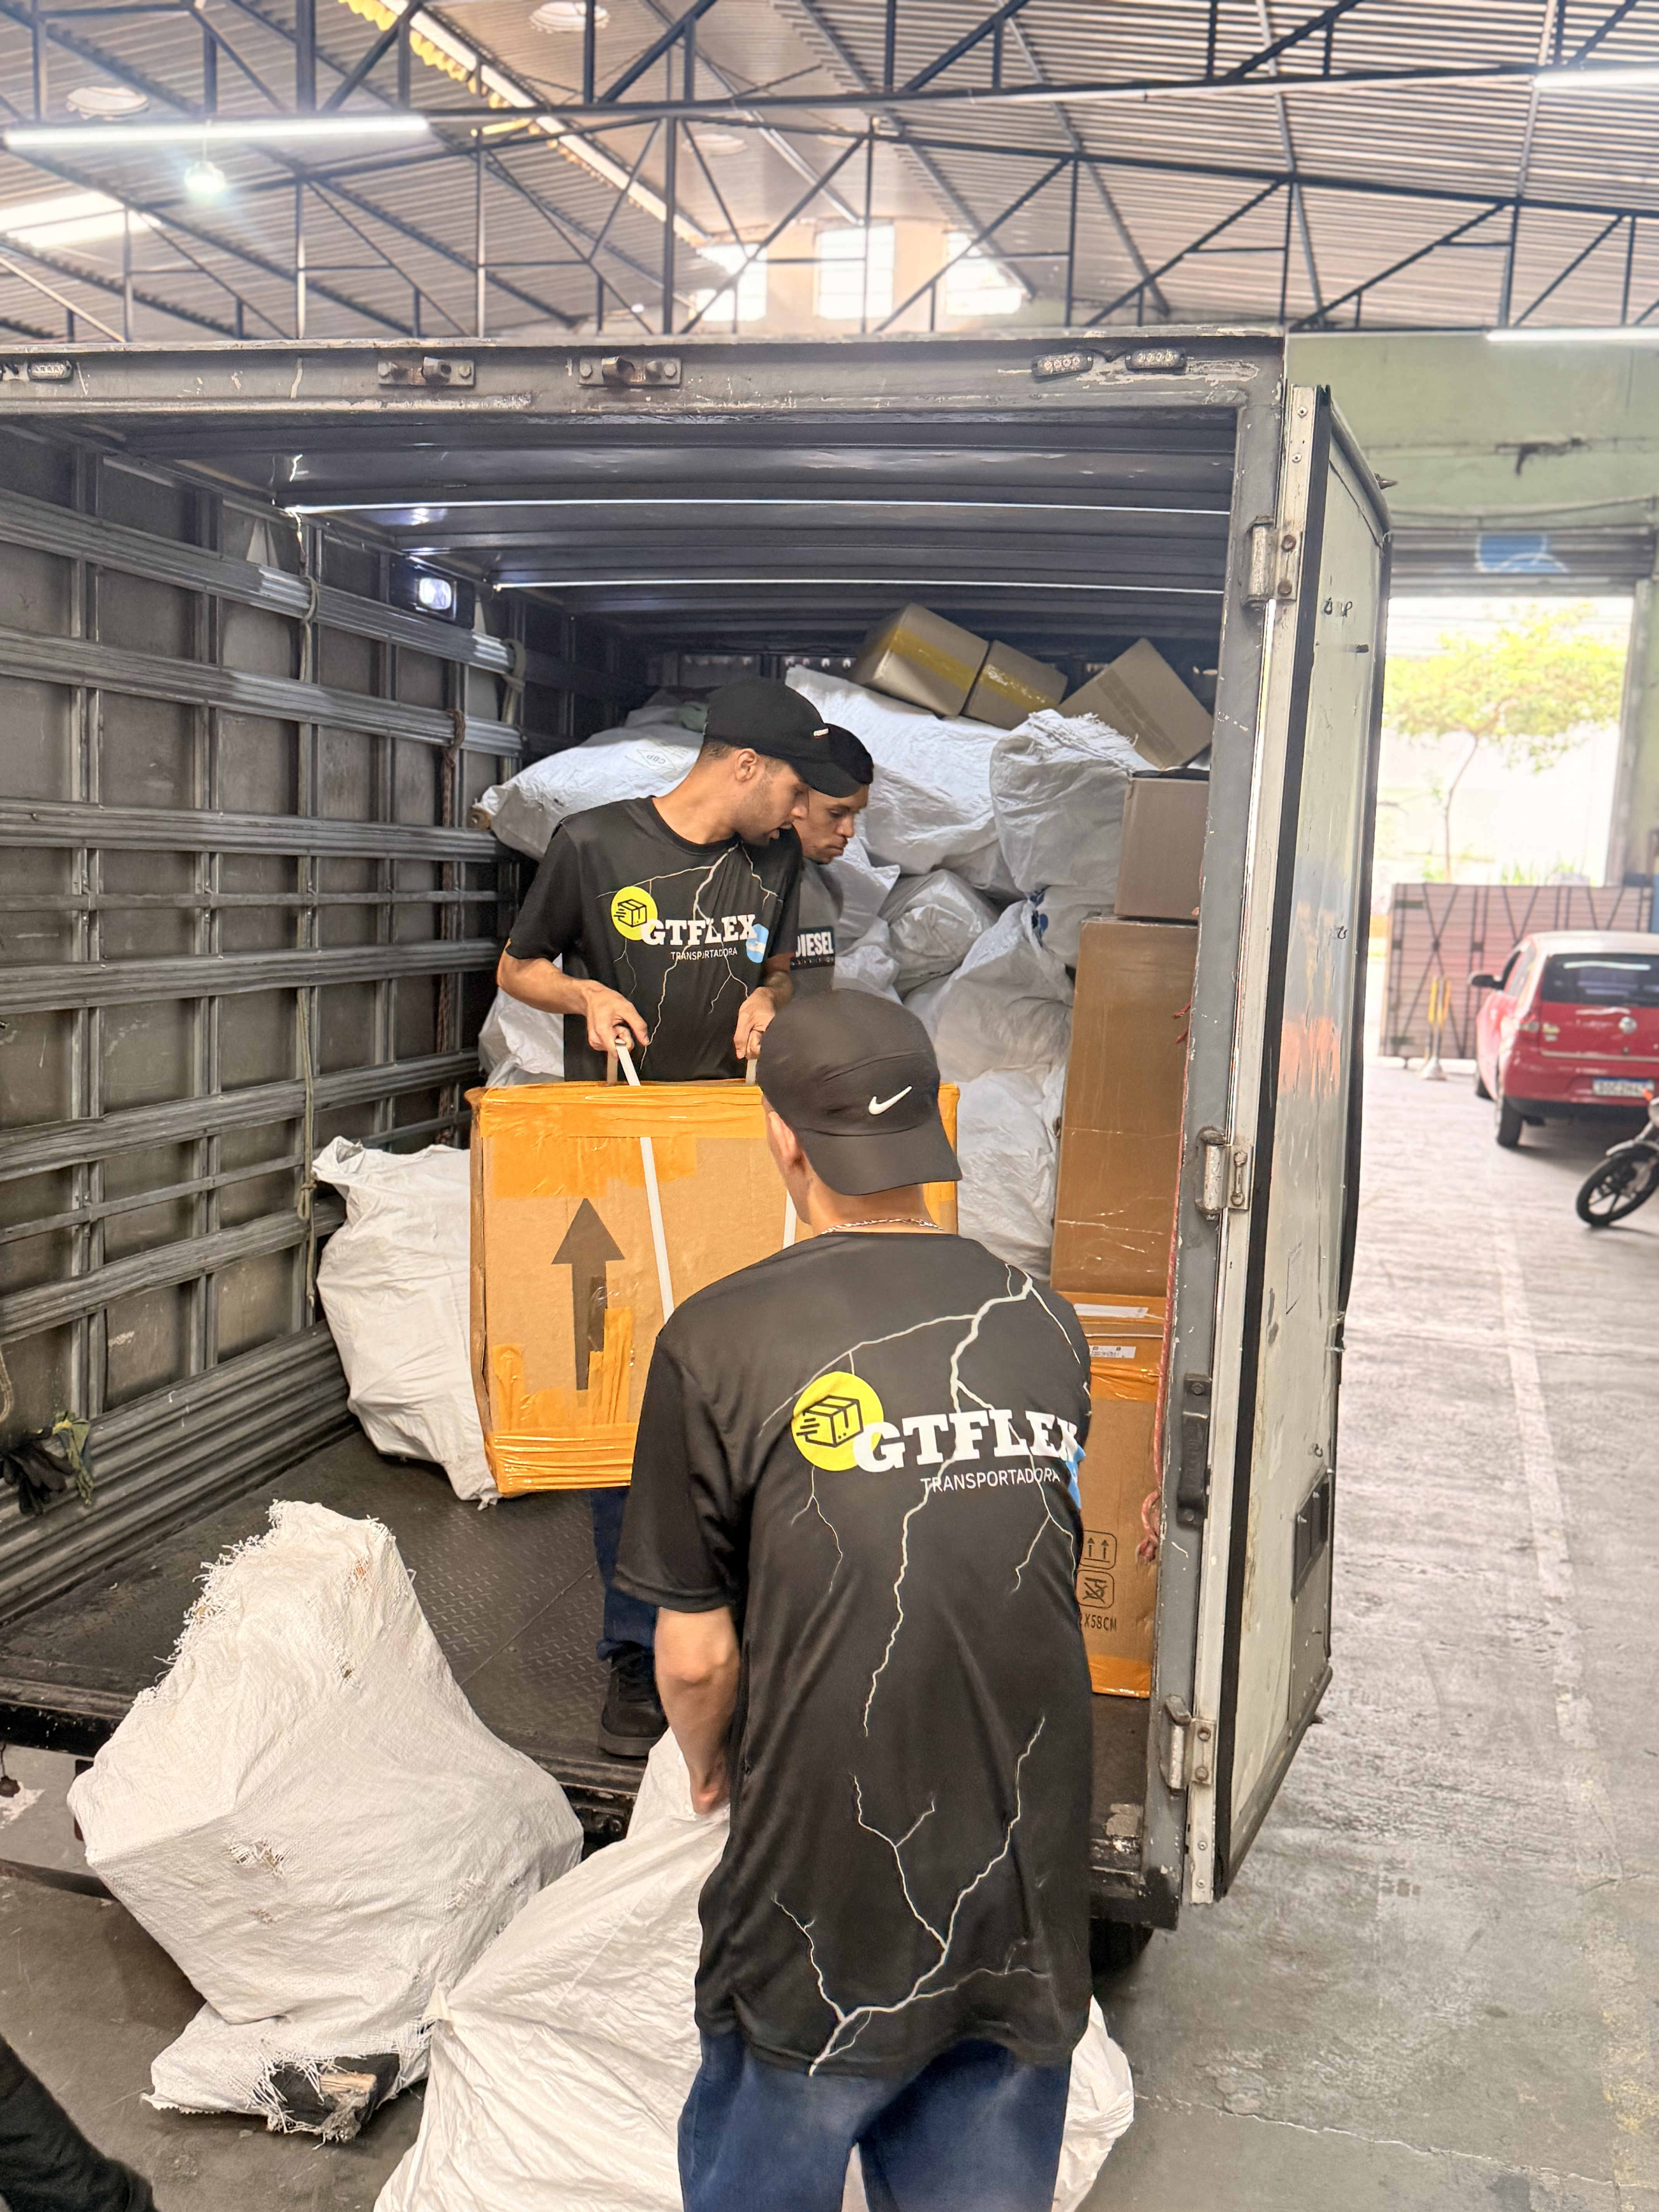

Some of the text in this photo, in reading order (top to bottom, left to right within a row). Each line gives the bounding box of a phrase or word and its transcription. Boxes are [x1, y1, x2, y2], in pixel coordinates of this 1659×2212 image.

[642, 914, 757, 946] GTFLEX
[853, 1409, 1077, 1472] GTFLEX
[920, 1467, 1060, 1492] TRANSPORTADORA
